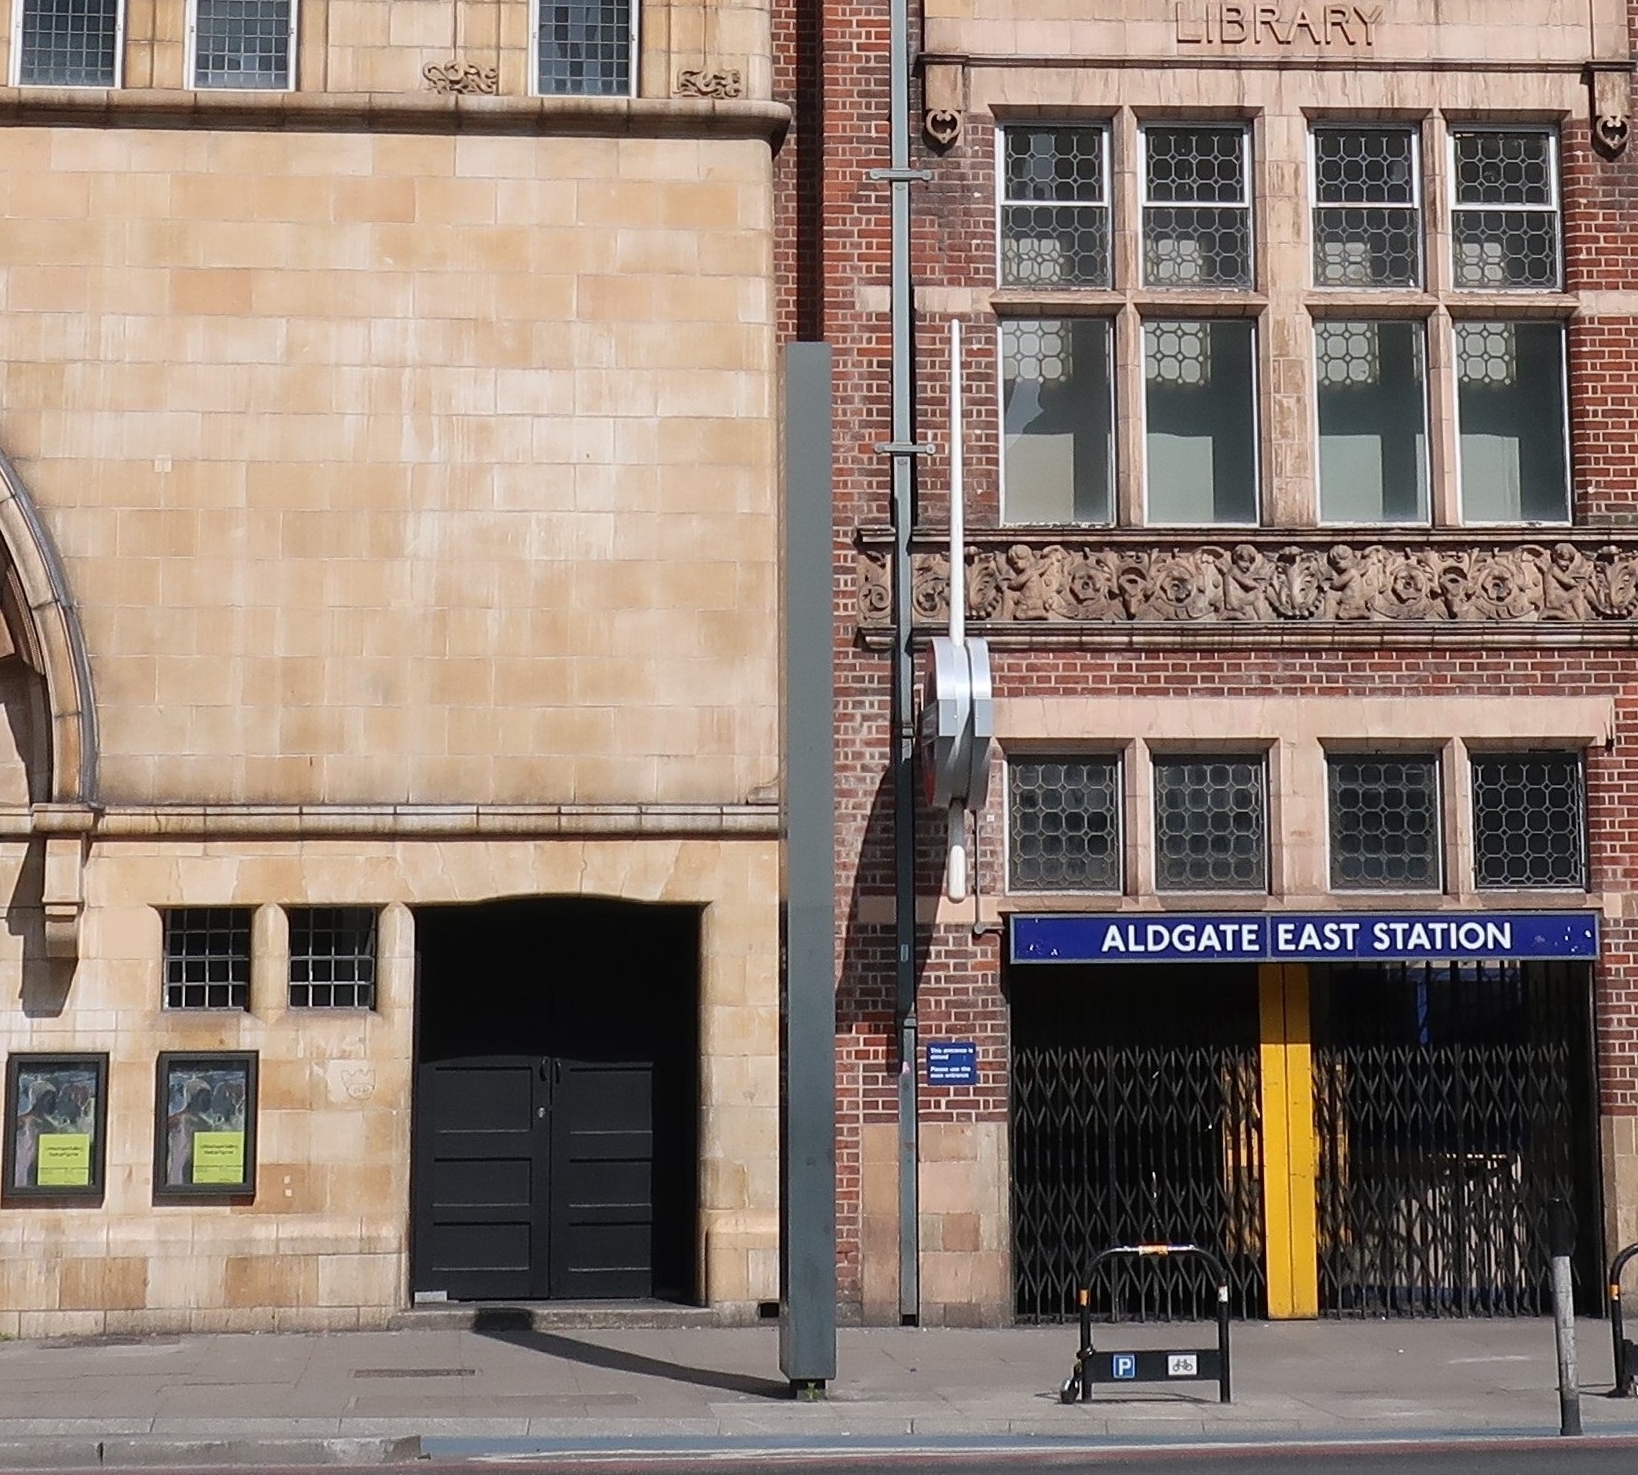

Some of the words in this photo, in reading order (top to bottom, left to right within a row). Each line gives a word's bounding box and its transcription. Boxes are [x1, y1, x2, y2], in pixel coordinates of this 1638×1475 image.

[1175, 2, 1384, 46] LIBRARY
[1101, 924, 1261, 953] ALDGATE
[1277, 923, 1360, 952] EAST
[1372, 922, 1512, 951] STATION
[1118, 1359, 1132, 1375] P
